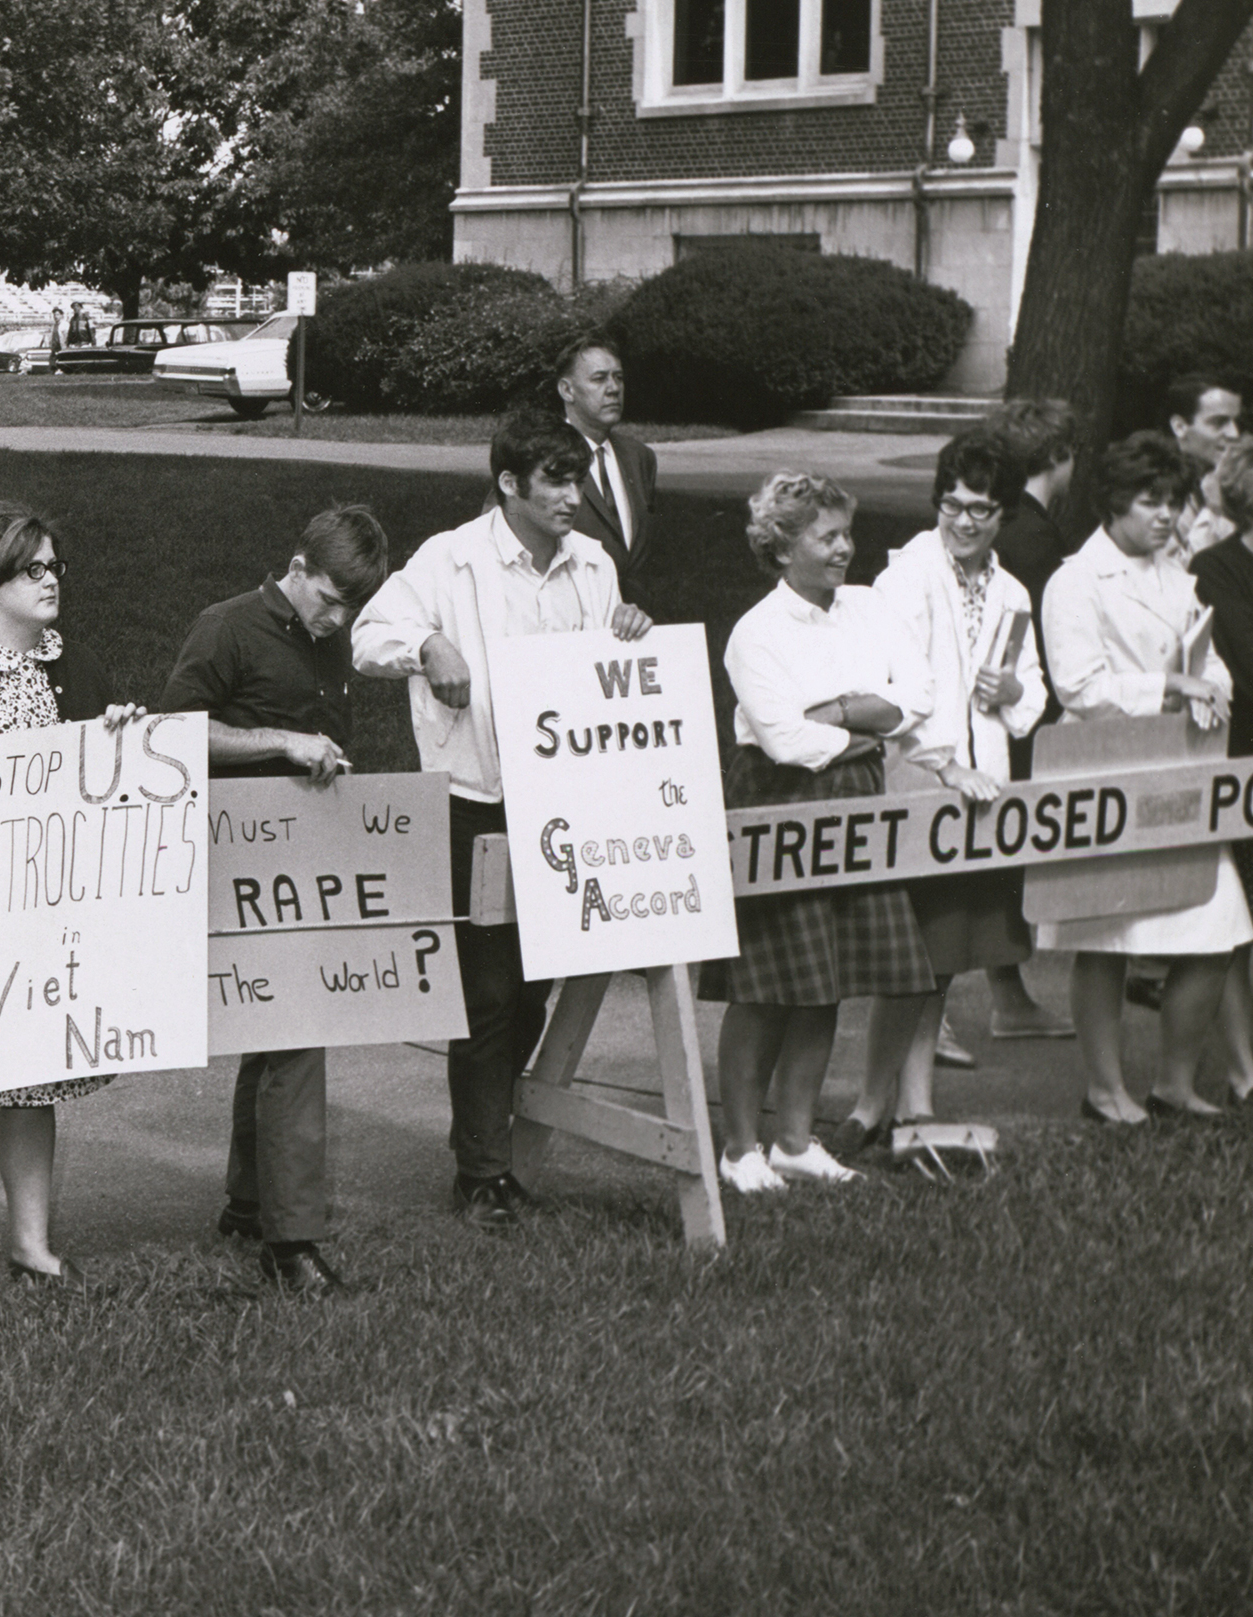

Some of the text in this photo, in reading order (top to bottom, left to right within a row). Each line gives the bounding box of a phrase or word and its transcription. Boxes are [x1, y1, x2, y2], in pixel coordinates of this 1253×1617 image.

[594, 656, 662, 699] WE
[78, 713, 199, 805] U.S.
[362, 803, 412, 835] We
[658, 777, 688, 808] the
[540, 817, 697, 894] Geneva
[727, 808, 909, 884] TREET
[929, 786, 1128, 865] CLOSED
[1209, 774, 1253, 833] P
[232, 873, 390, 928] RAPE
[581, 873, 702, 932] Accord
[62, 927, 81, 945] in
[208, 962, 275, 1007] The
[65, 1006, 158, 1070] Nam
